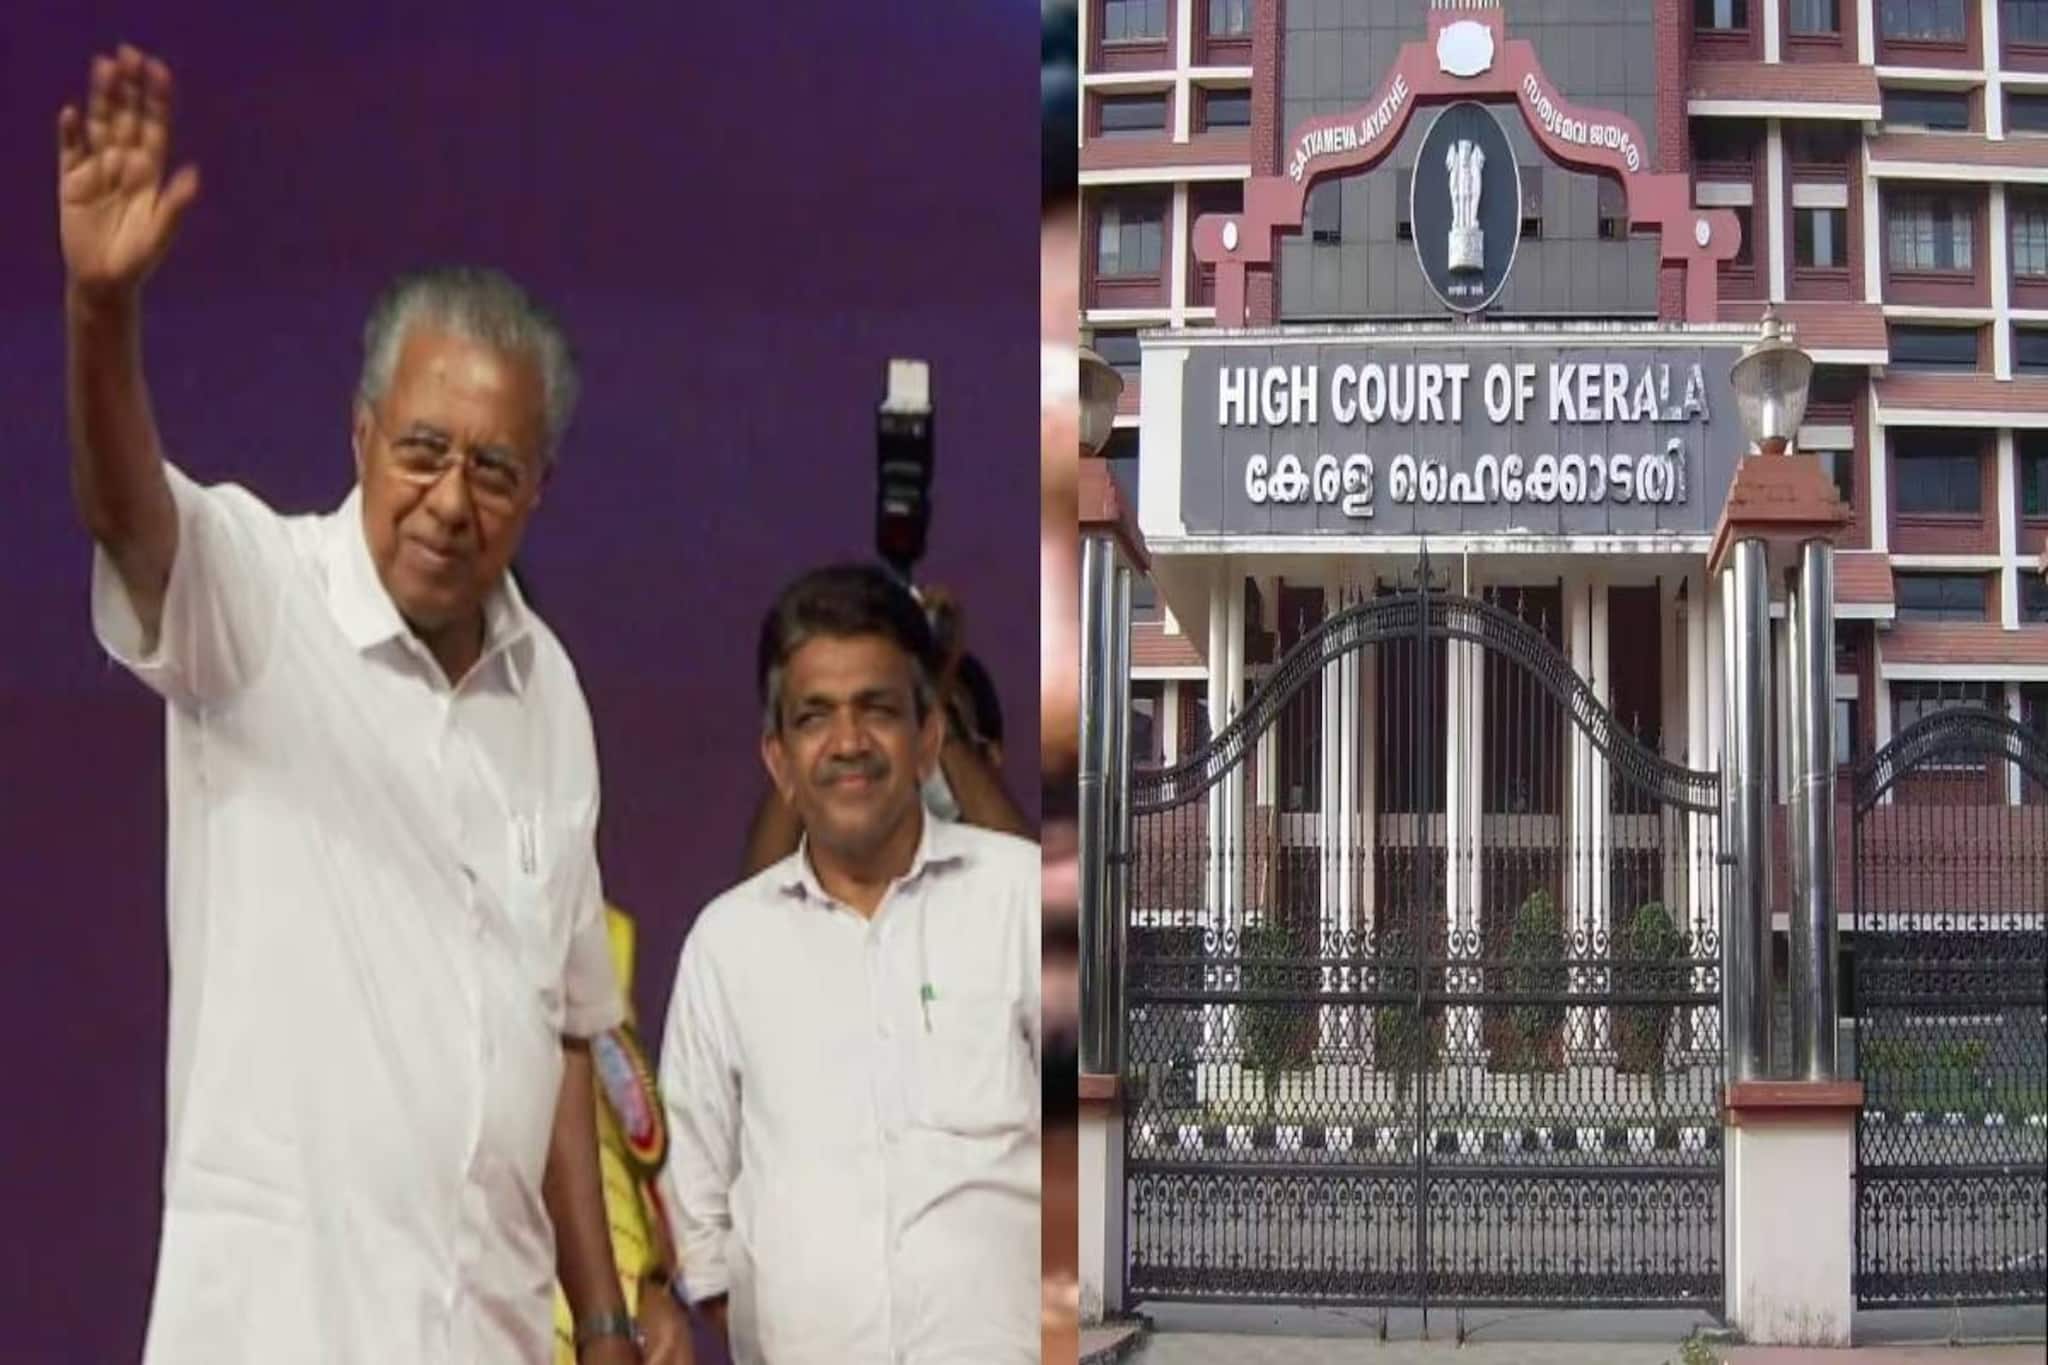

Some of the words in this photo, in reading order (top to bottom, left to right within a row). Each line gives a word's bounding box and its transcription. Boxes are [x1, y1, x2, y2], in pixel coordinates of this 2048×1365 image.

[1290, 125, 1357, 181] SATYAMEVA
[1359, 74, 1408, 146] JAYATHE
[1219, 366, 1319, 425] HIGH
[1331, 363, 1470, 424] COURT
[1484, 362, 1536, 423] OF
[1550, 363, 1710, 422] KERALA
[1245, 454, 1374, 517] കേരള
[1389, 437, 1687, 503] ഹൈക്കോടതി
